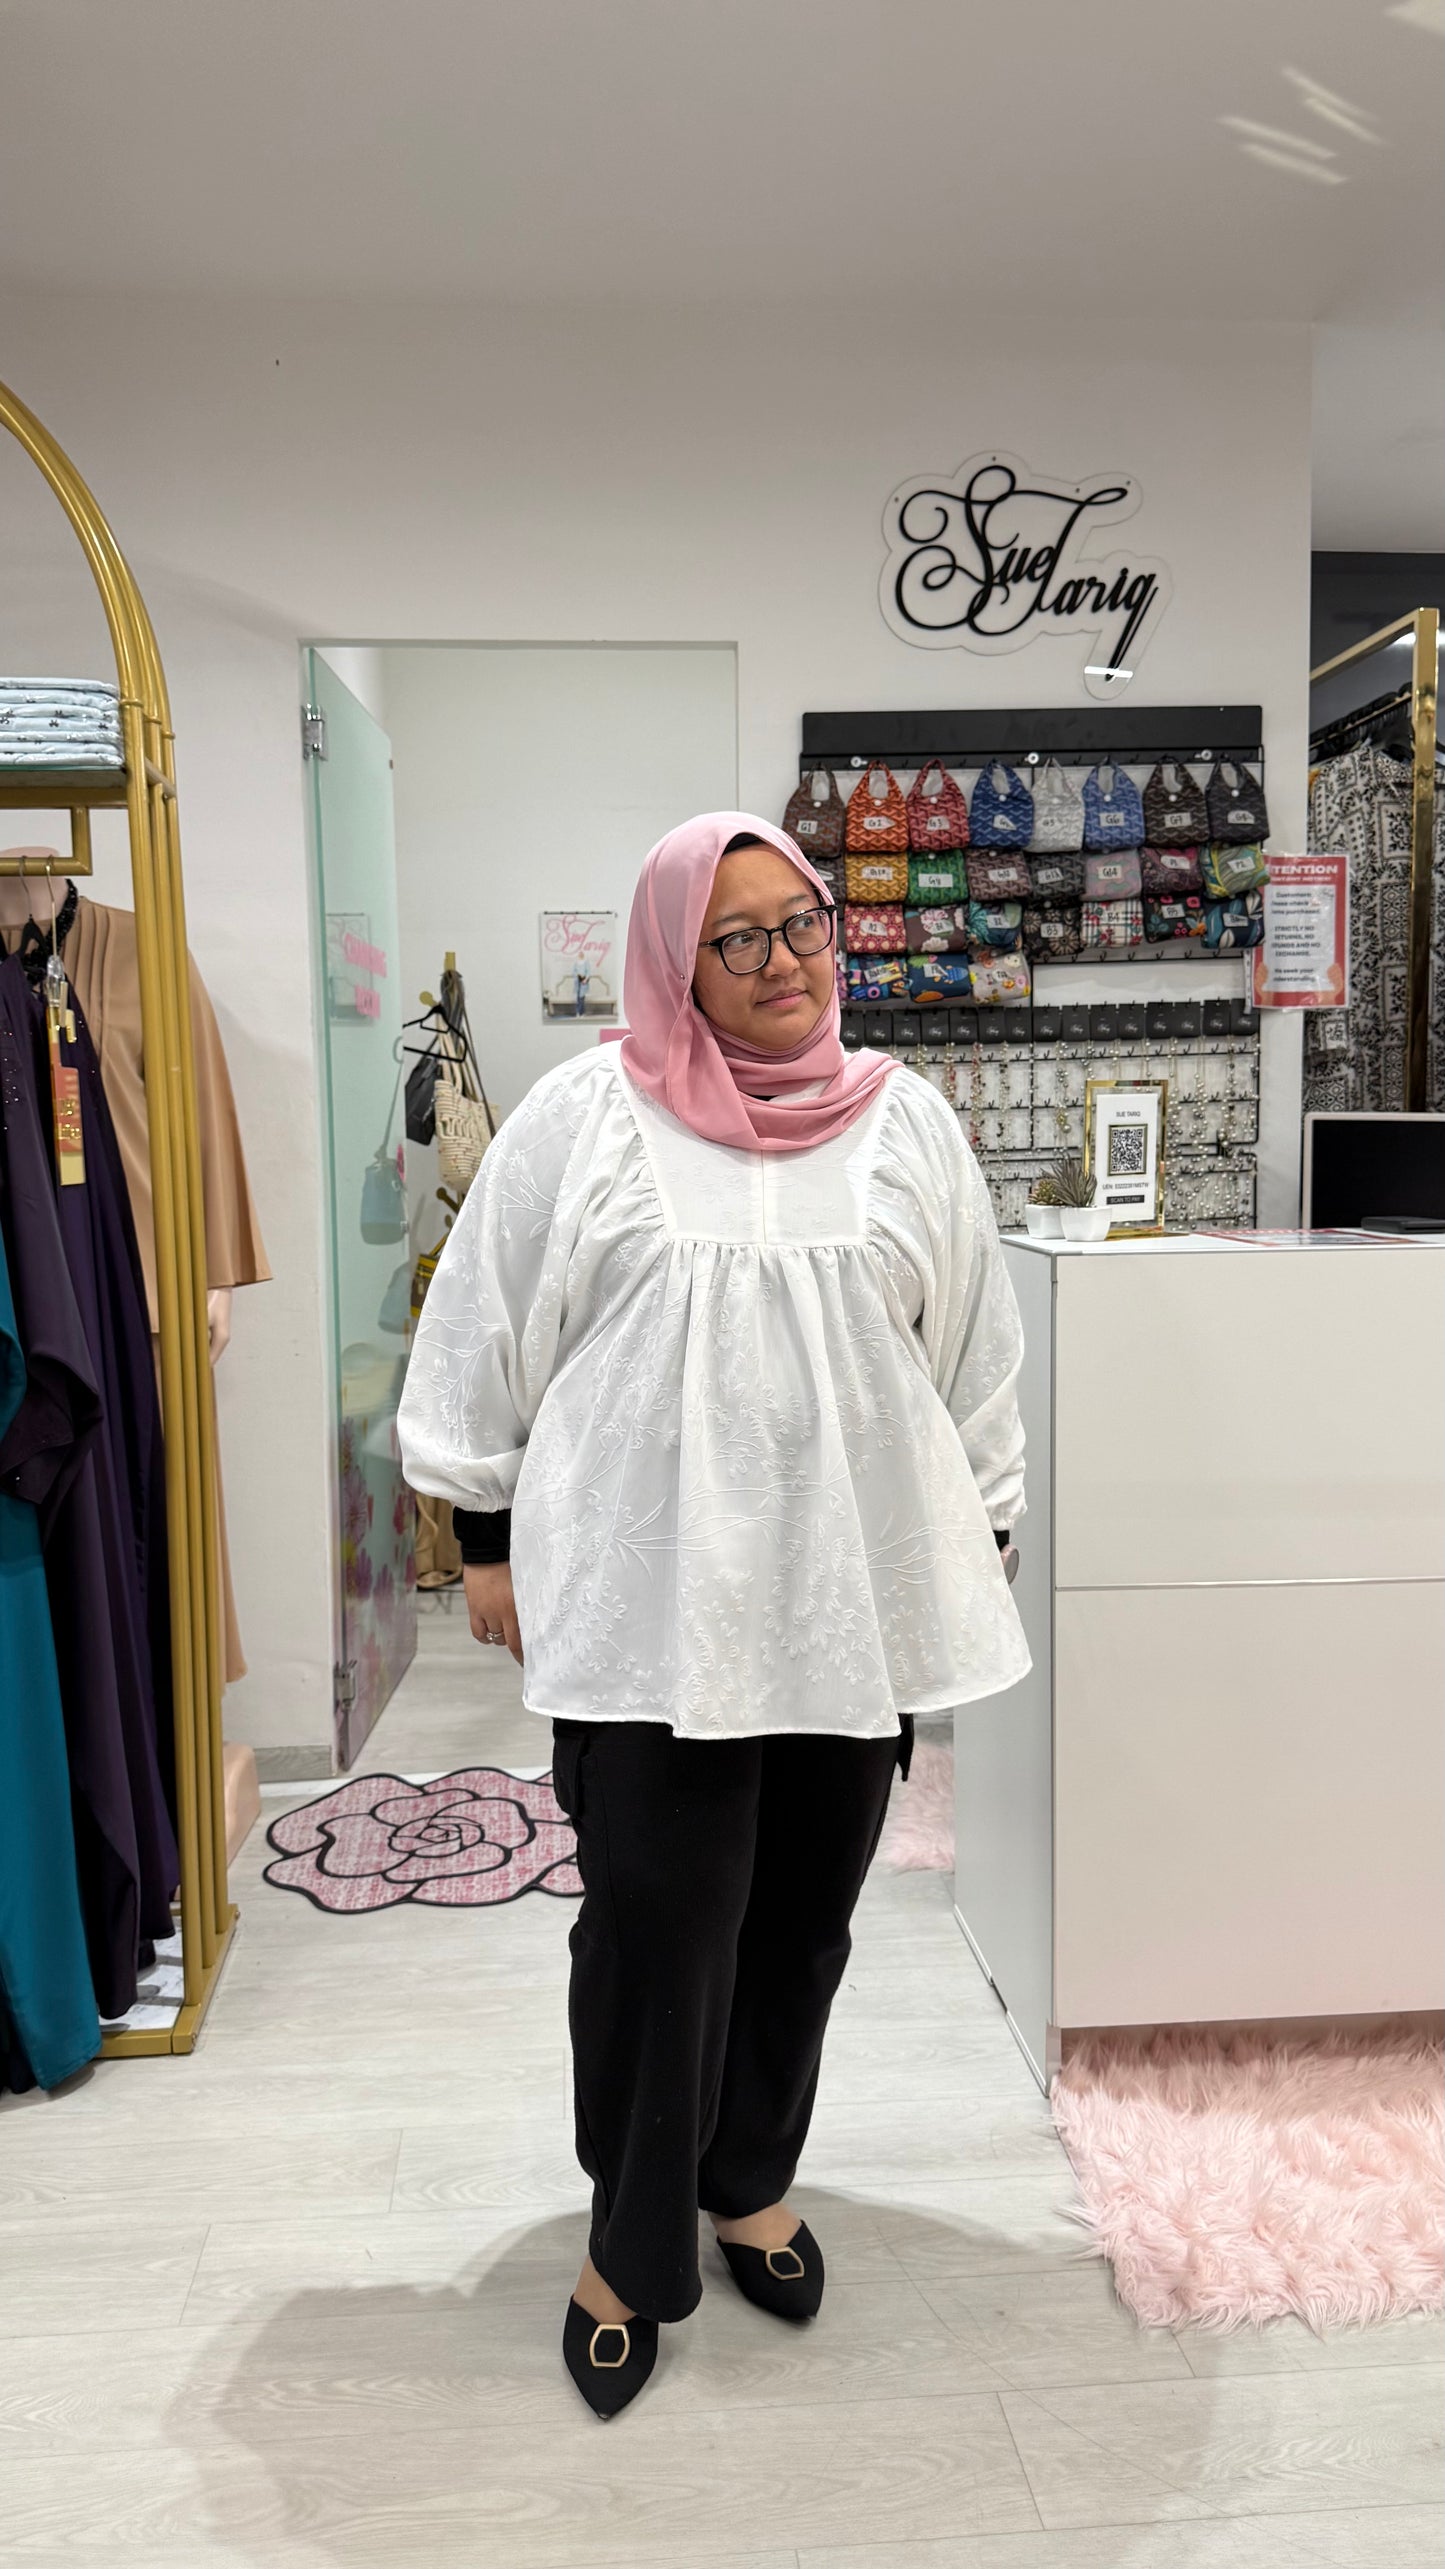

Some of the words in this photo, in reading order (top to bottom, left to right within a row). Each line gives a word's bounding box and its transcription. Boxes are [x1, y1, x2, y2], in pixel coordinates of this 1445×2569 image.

[868, 819, 882, 828] G2
[1105, 814, 1120, 824] G6
[1169, 815, 1183, 825] G7
[800, 822, 811, 833] G1
[1107, 912, 1120, 923] B4
